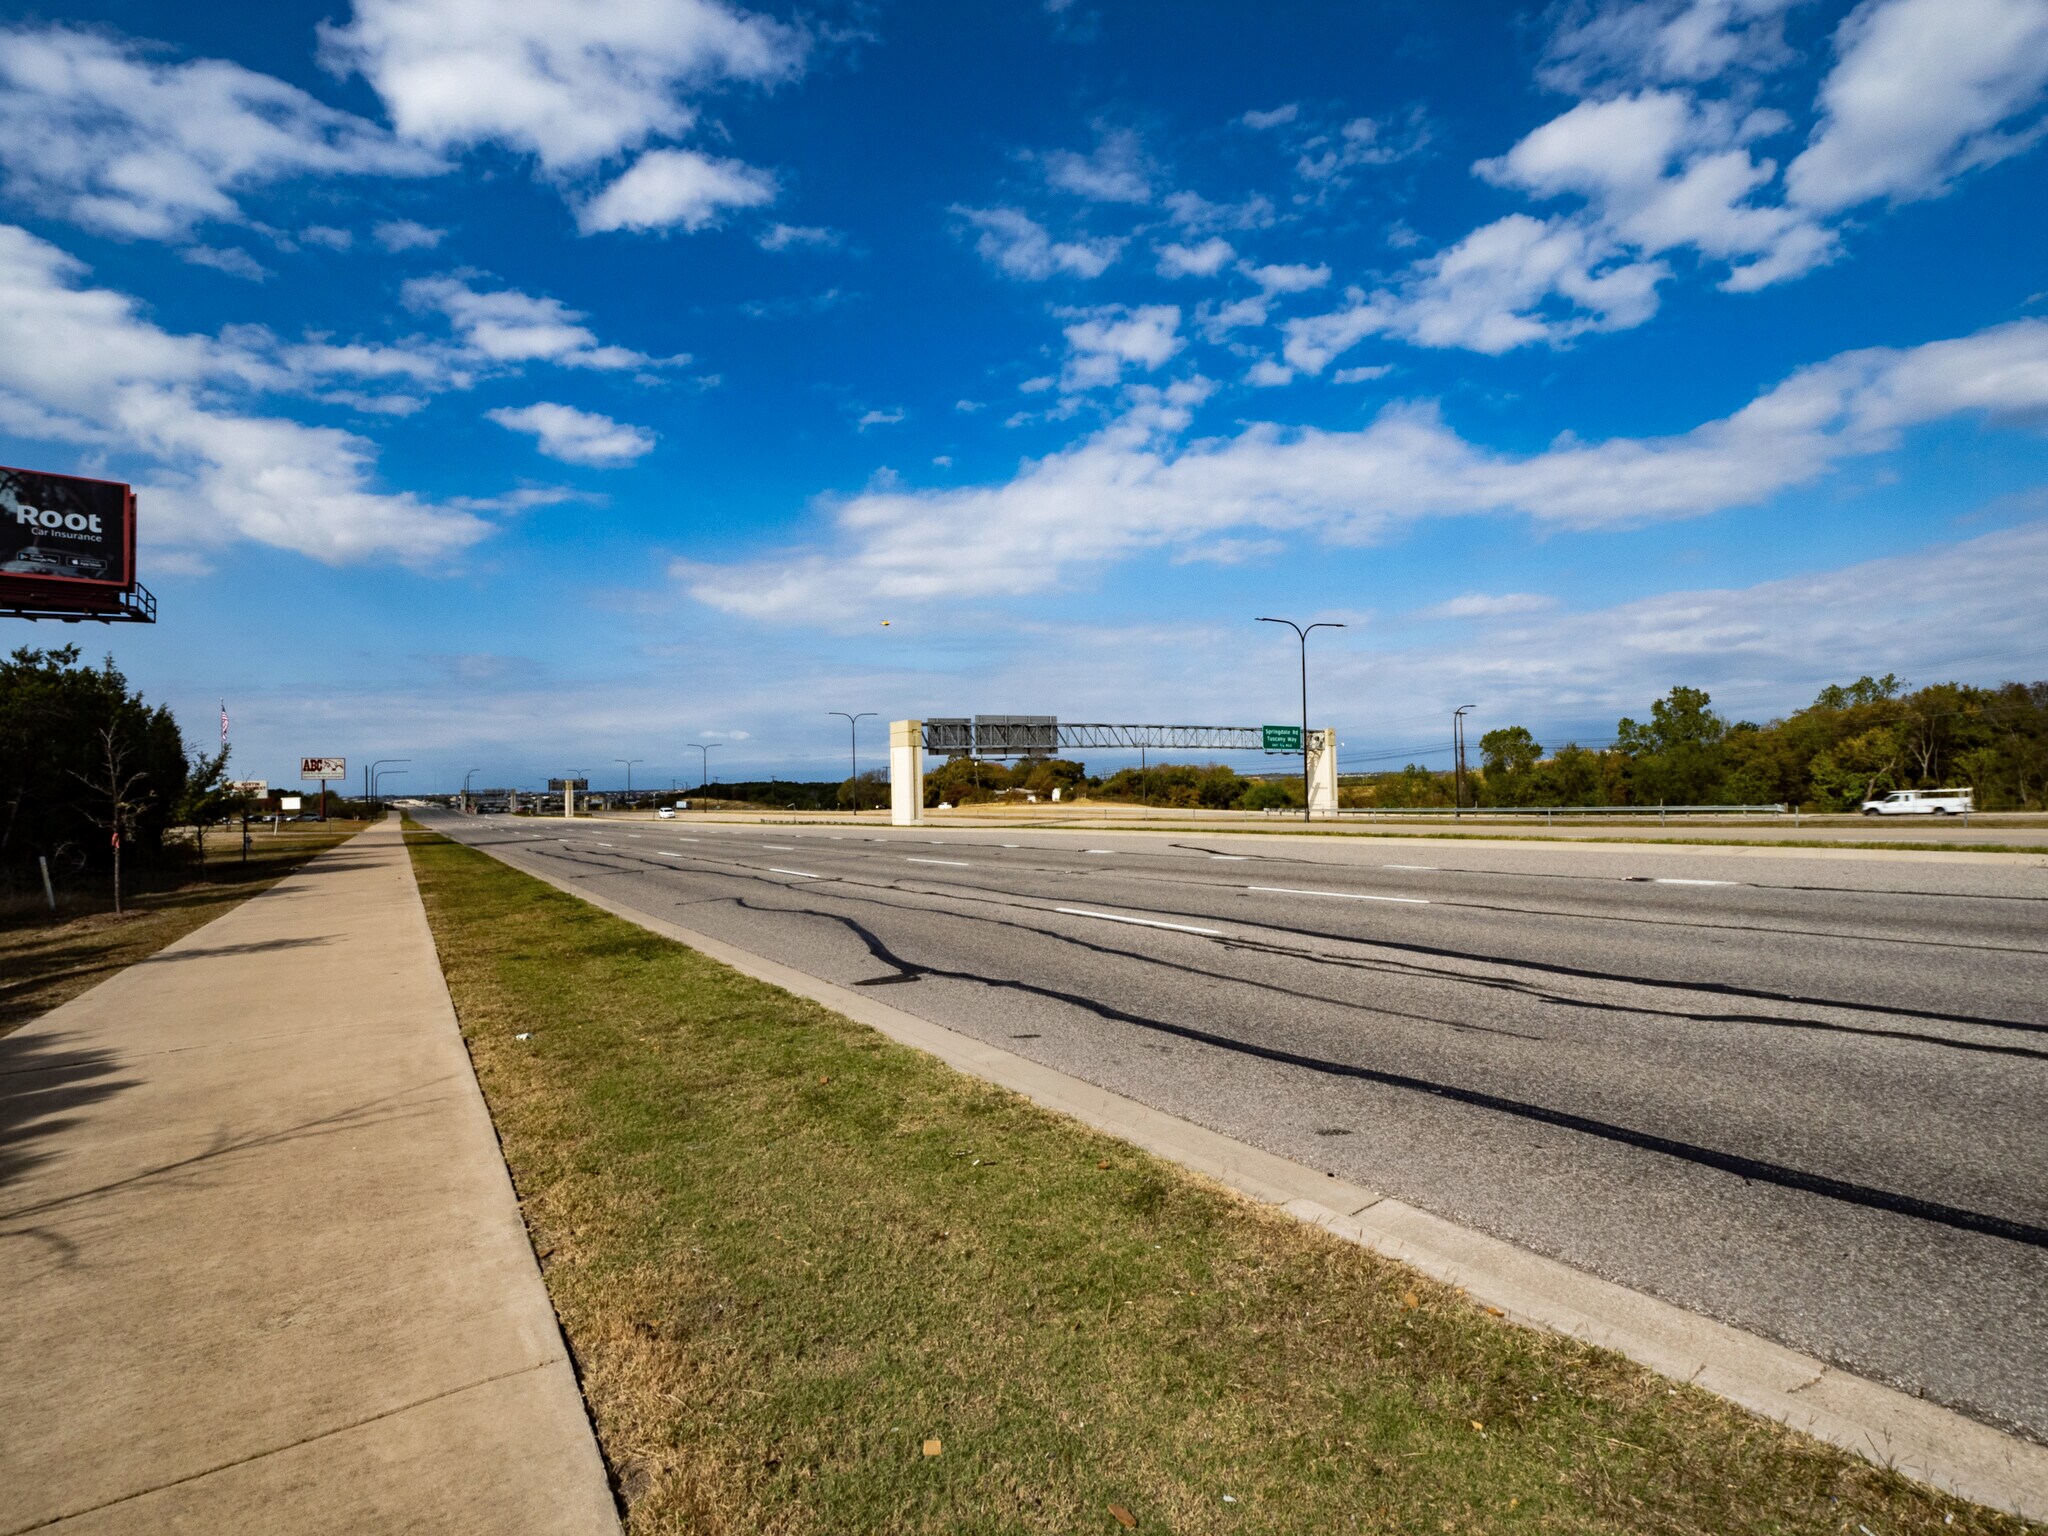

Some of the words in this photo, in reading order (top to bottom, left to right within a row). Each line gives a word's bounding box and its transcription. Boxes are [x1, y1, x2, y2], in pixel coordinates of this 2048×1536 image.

[16, 504, 103, 534] Root
[31, 527, 48, 537] Car
[51, 529, 103, 543] Insurance
[303, 759, 323, 772] ABC
